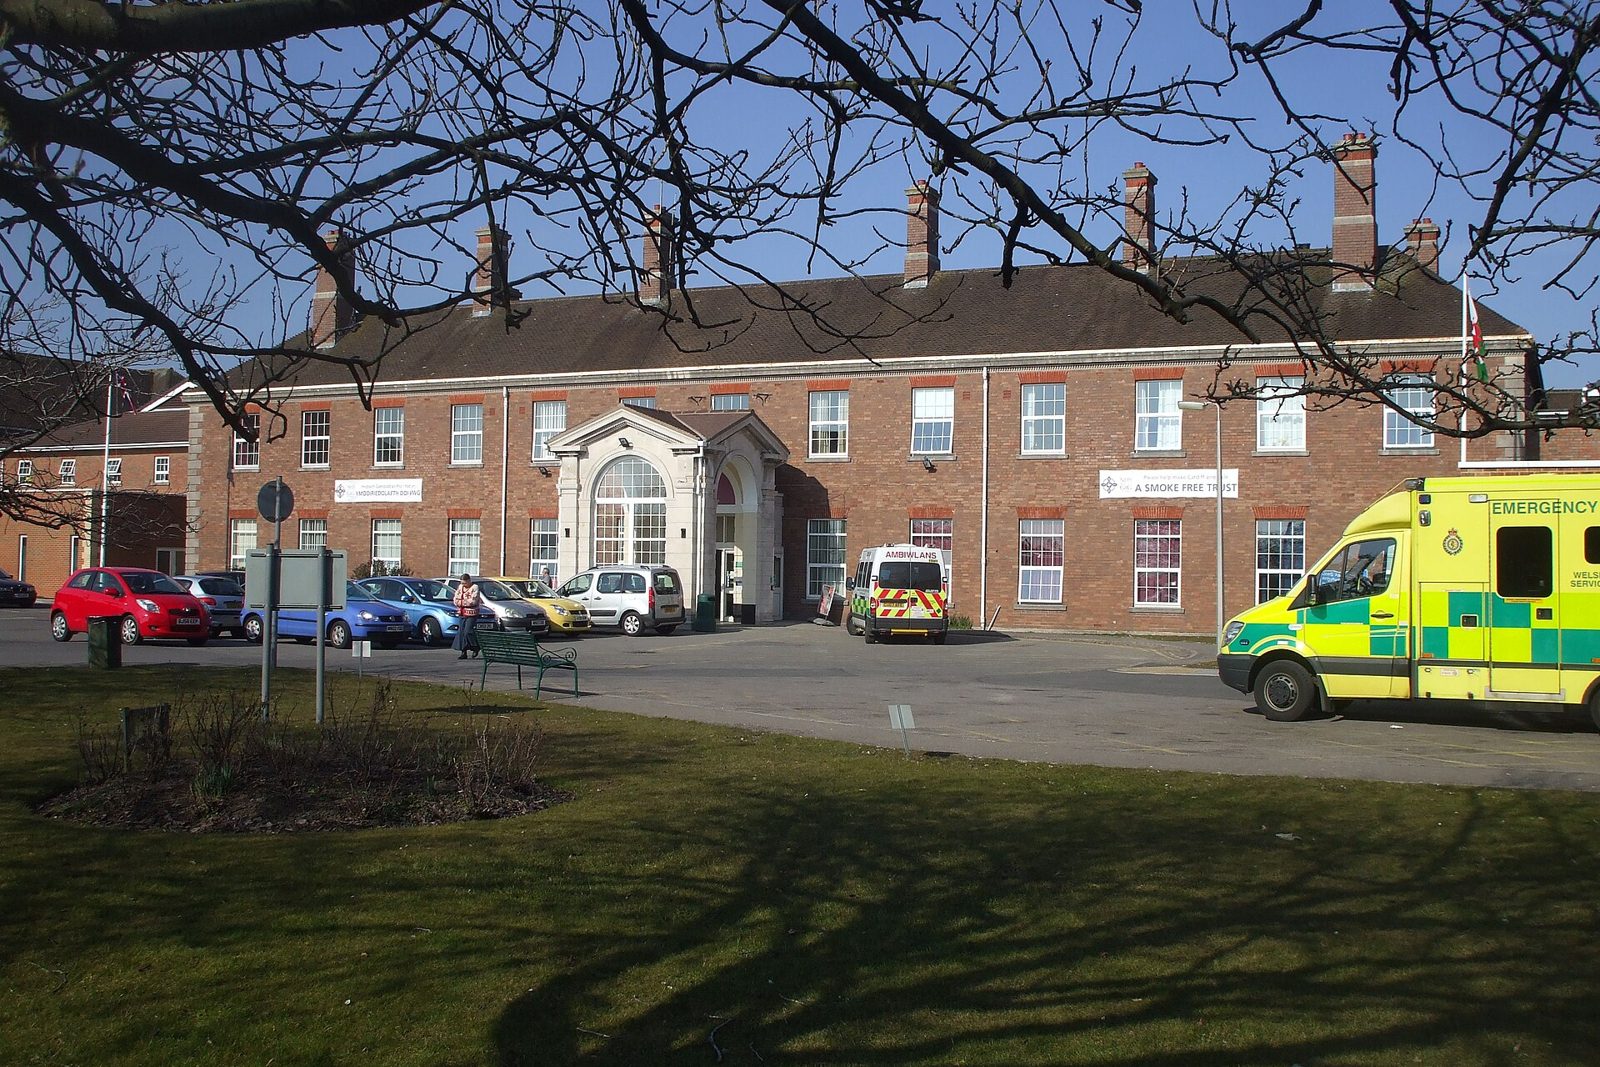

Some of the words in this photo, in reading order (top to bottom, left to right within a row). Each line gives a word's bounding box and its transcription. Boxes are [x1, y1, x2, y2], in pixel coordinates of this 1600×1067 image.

[1135, 484, 1142, 492] A
[1145, 483, 1179, 492] SMOKE
[1182, 483, 1204, 492] FREE
[1492, 501, 1598, 514] EMERGENCY
[885, 551, 937, 559] AMBIWLANS
[1573, 571, 1600, 579] WELS
